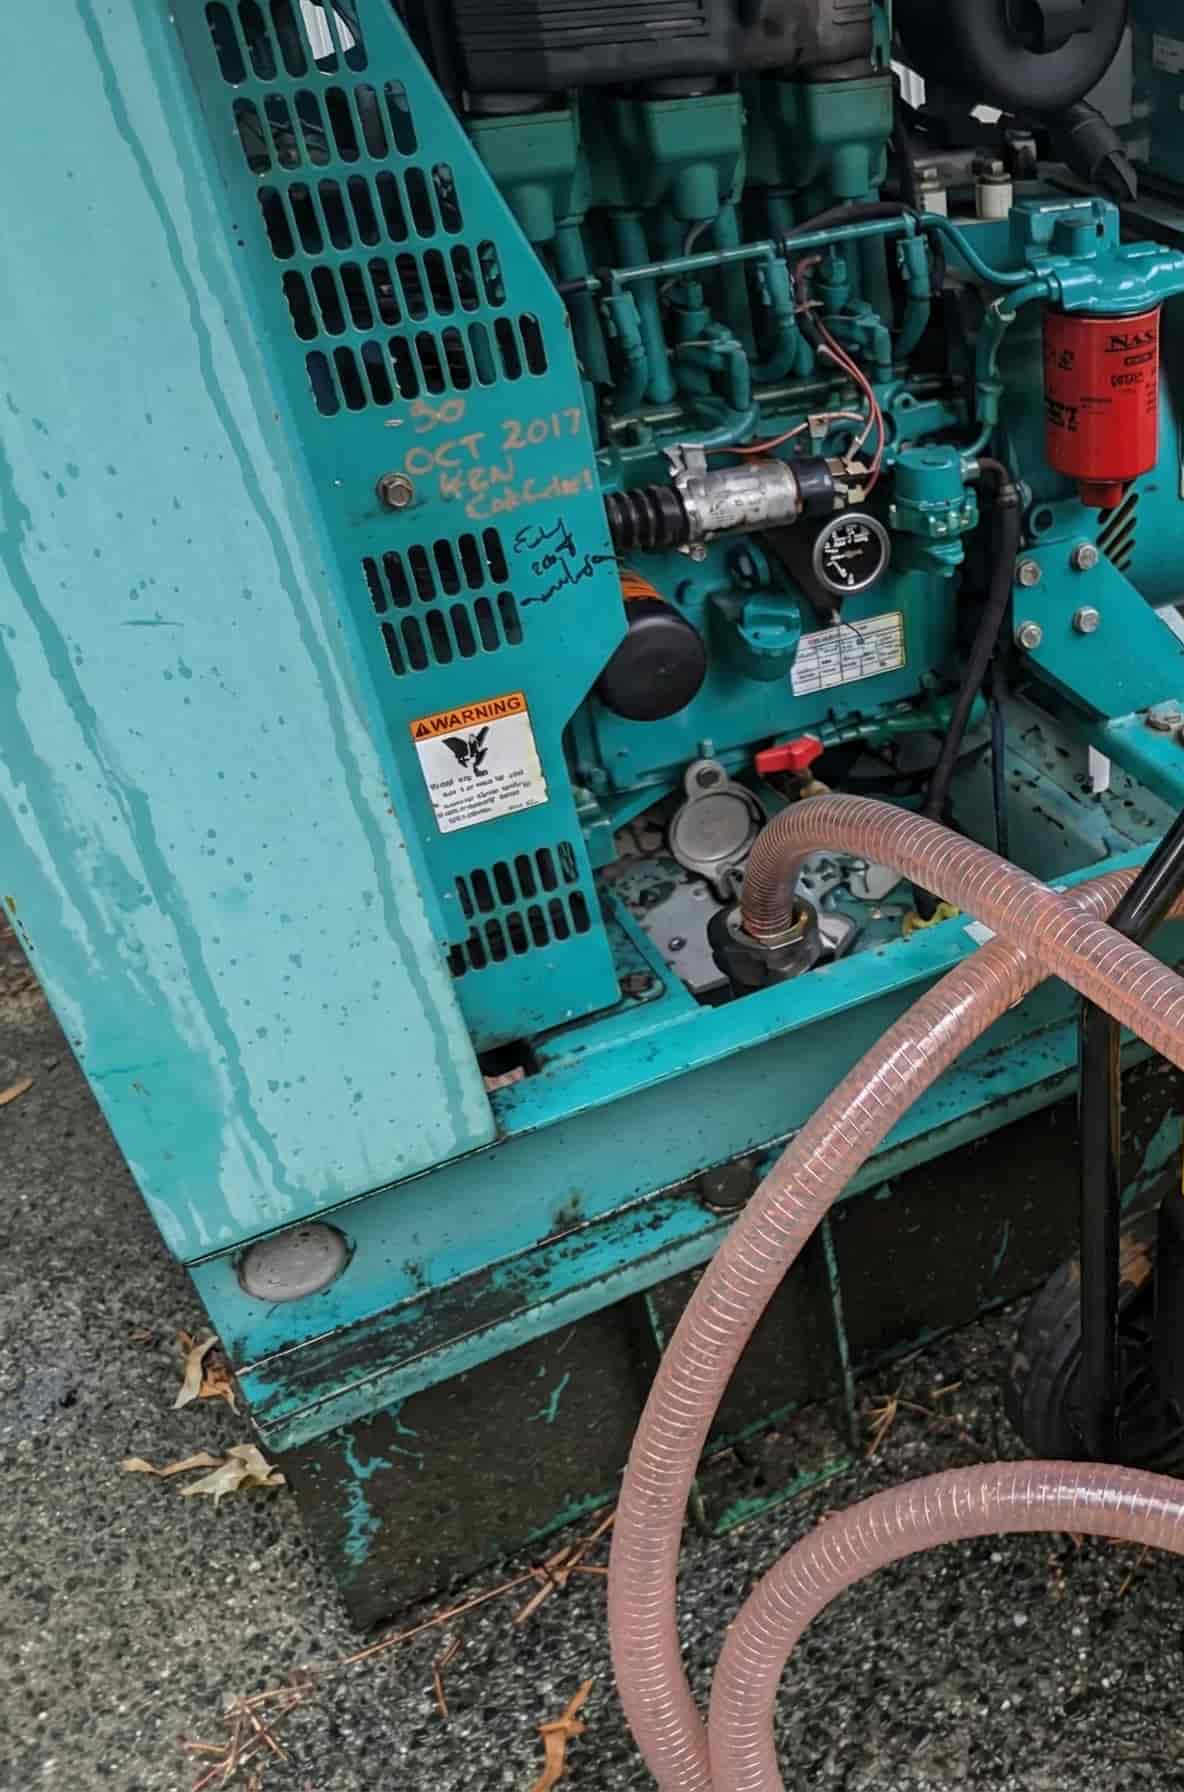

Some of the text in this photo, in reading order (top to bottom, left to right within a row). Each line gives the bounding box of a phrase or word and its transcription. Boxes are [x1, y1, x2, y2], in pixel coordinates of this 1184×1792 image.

[405, 407, 580, 475] OCT 2017
[430, 696, 521, 732] WARNING
